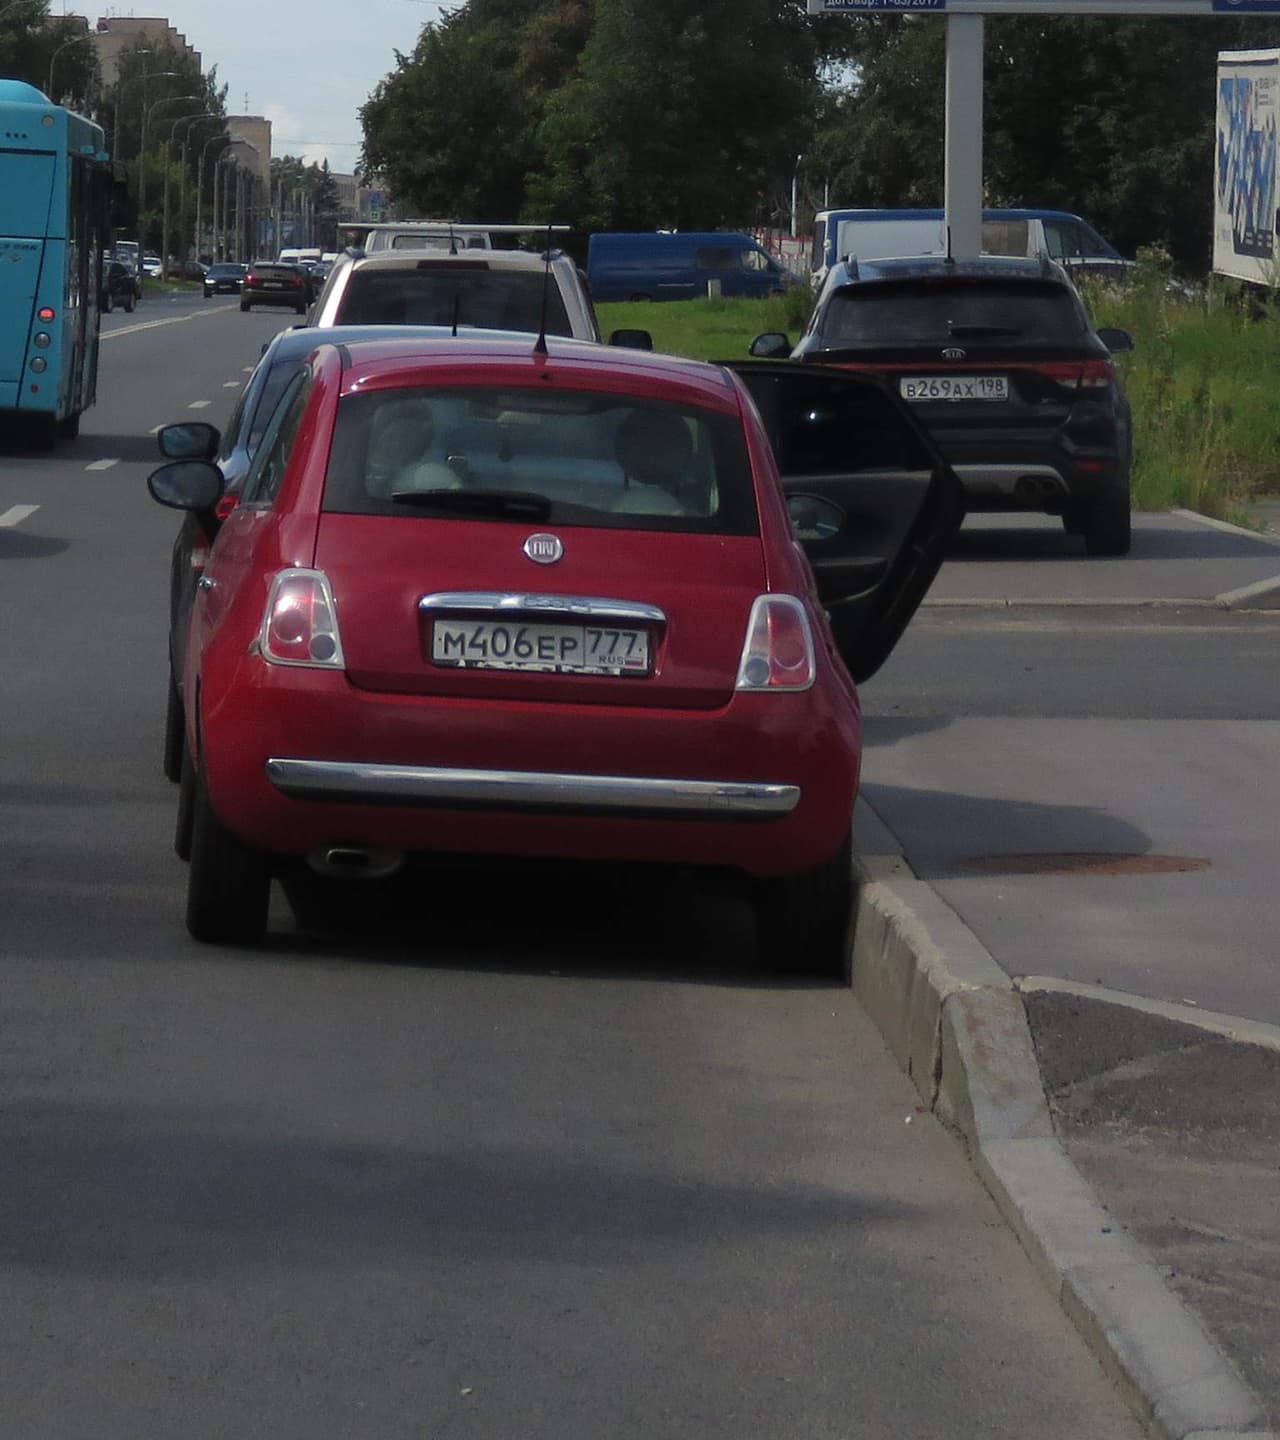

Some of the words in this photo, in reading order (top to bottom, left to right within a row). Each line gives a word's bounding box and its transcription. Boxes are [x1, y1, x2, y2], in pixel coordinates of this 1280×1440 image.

[906, 380, 974, 397] В269АХ
[978, 379, 1004, 393] 198
[443, 626, 578, 661] М406ЕР
[587, 630, 638, 655] 777
[599, 655, 625, 665] RUS
